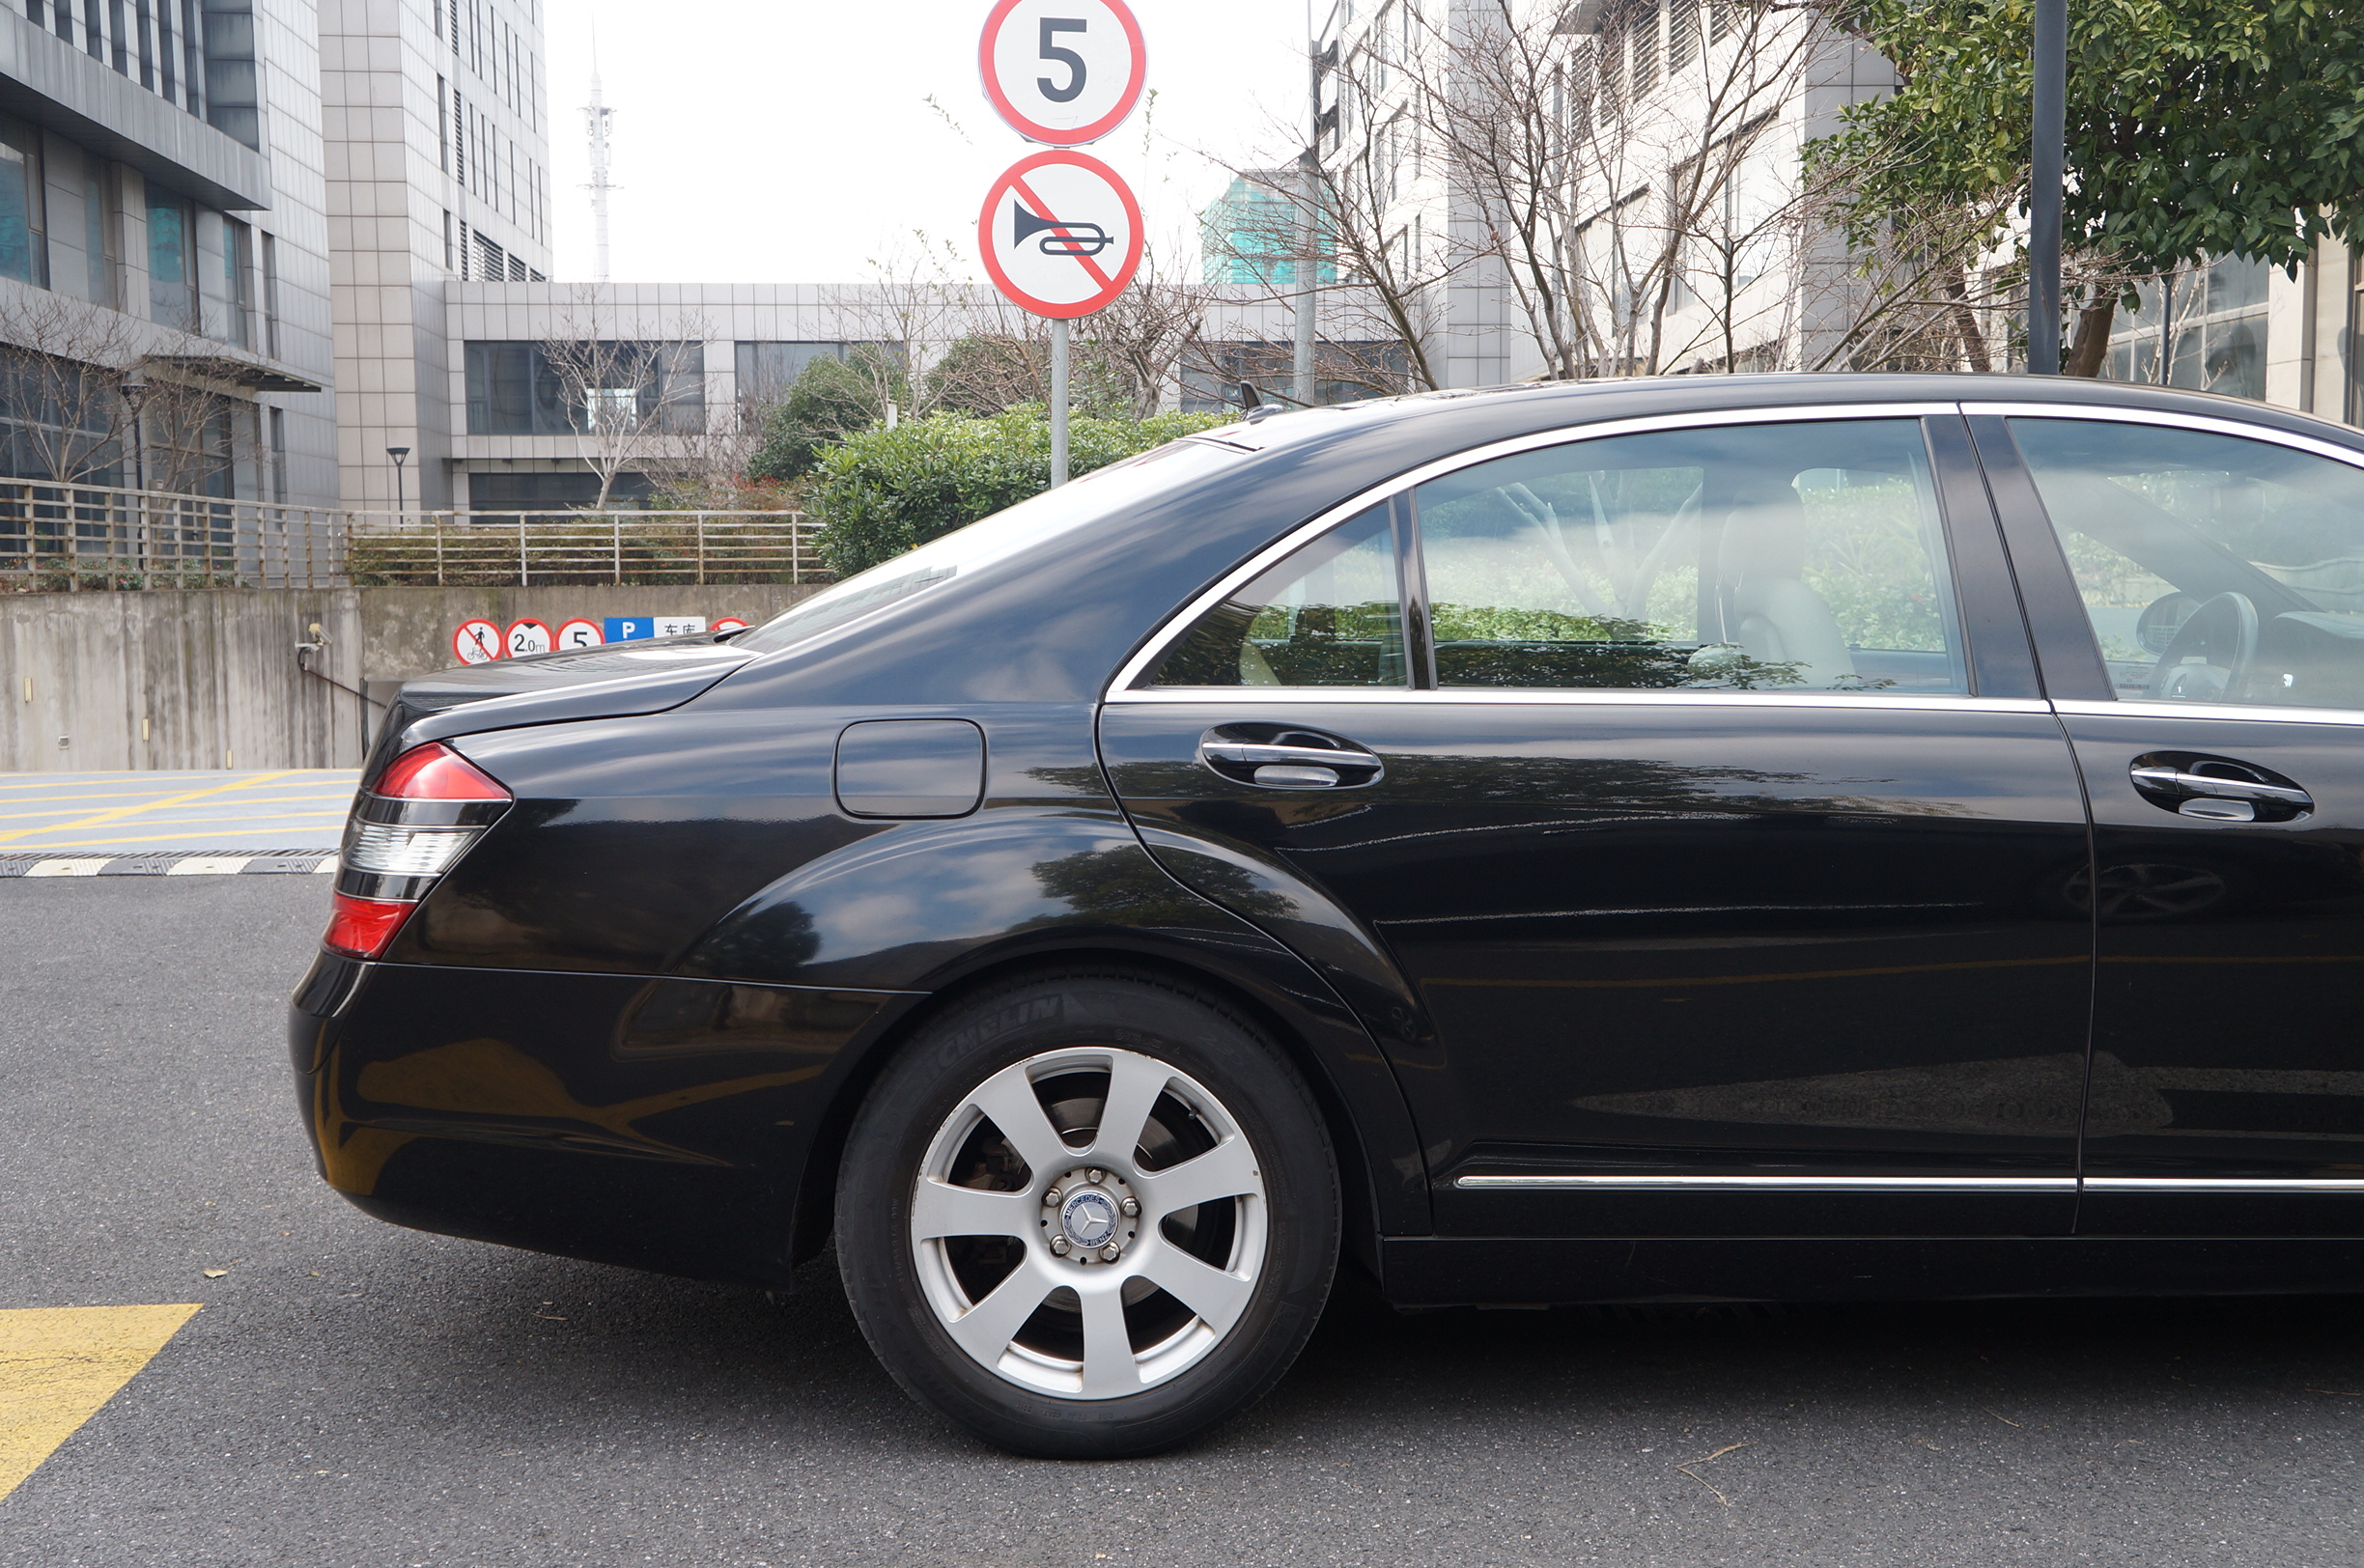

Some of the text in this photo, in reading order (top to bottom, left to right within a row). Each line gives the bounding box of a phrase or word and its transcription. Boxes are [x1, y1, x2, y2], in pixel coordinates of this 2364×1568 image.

[1036, 16, 1087, 103] 5
[574, 631, 588, 647] 5
[622, 621, 635, 639] P
